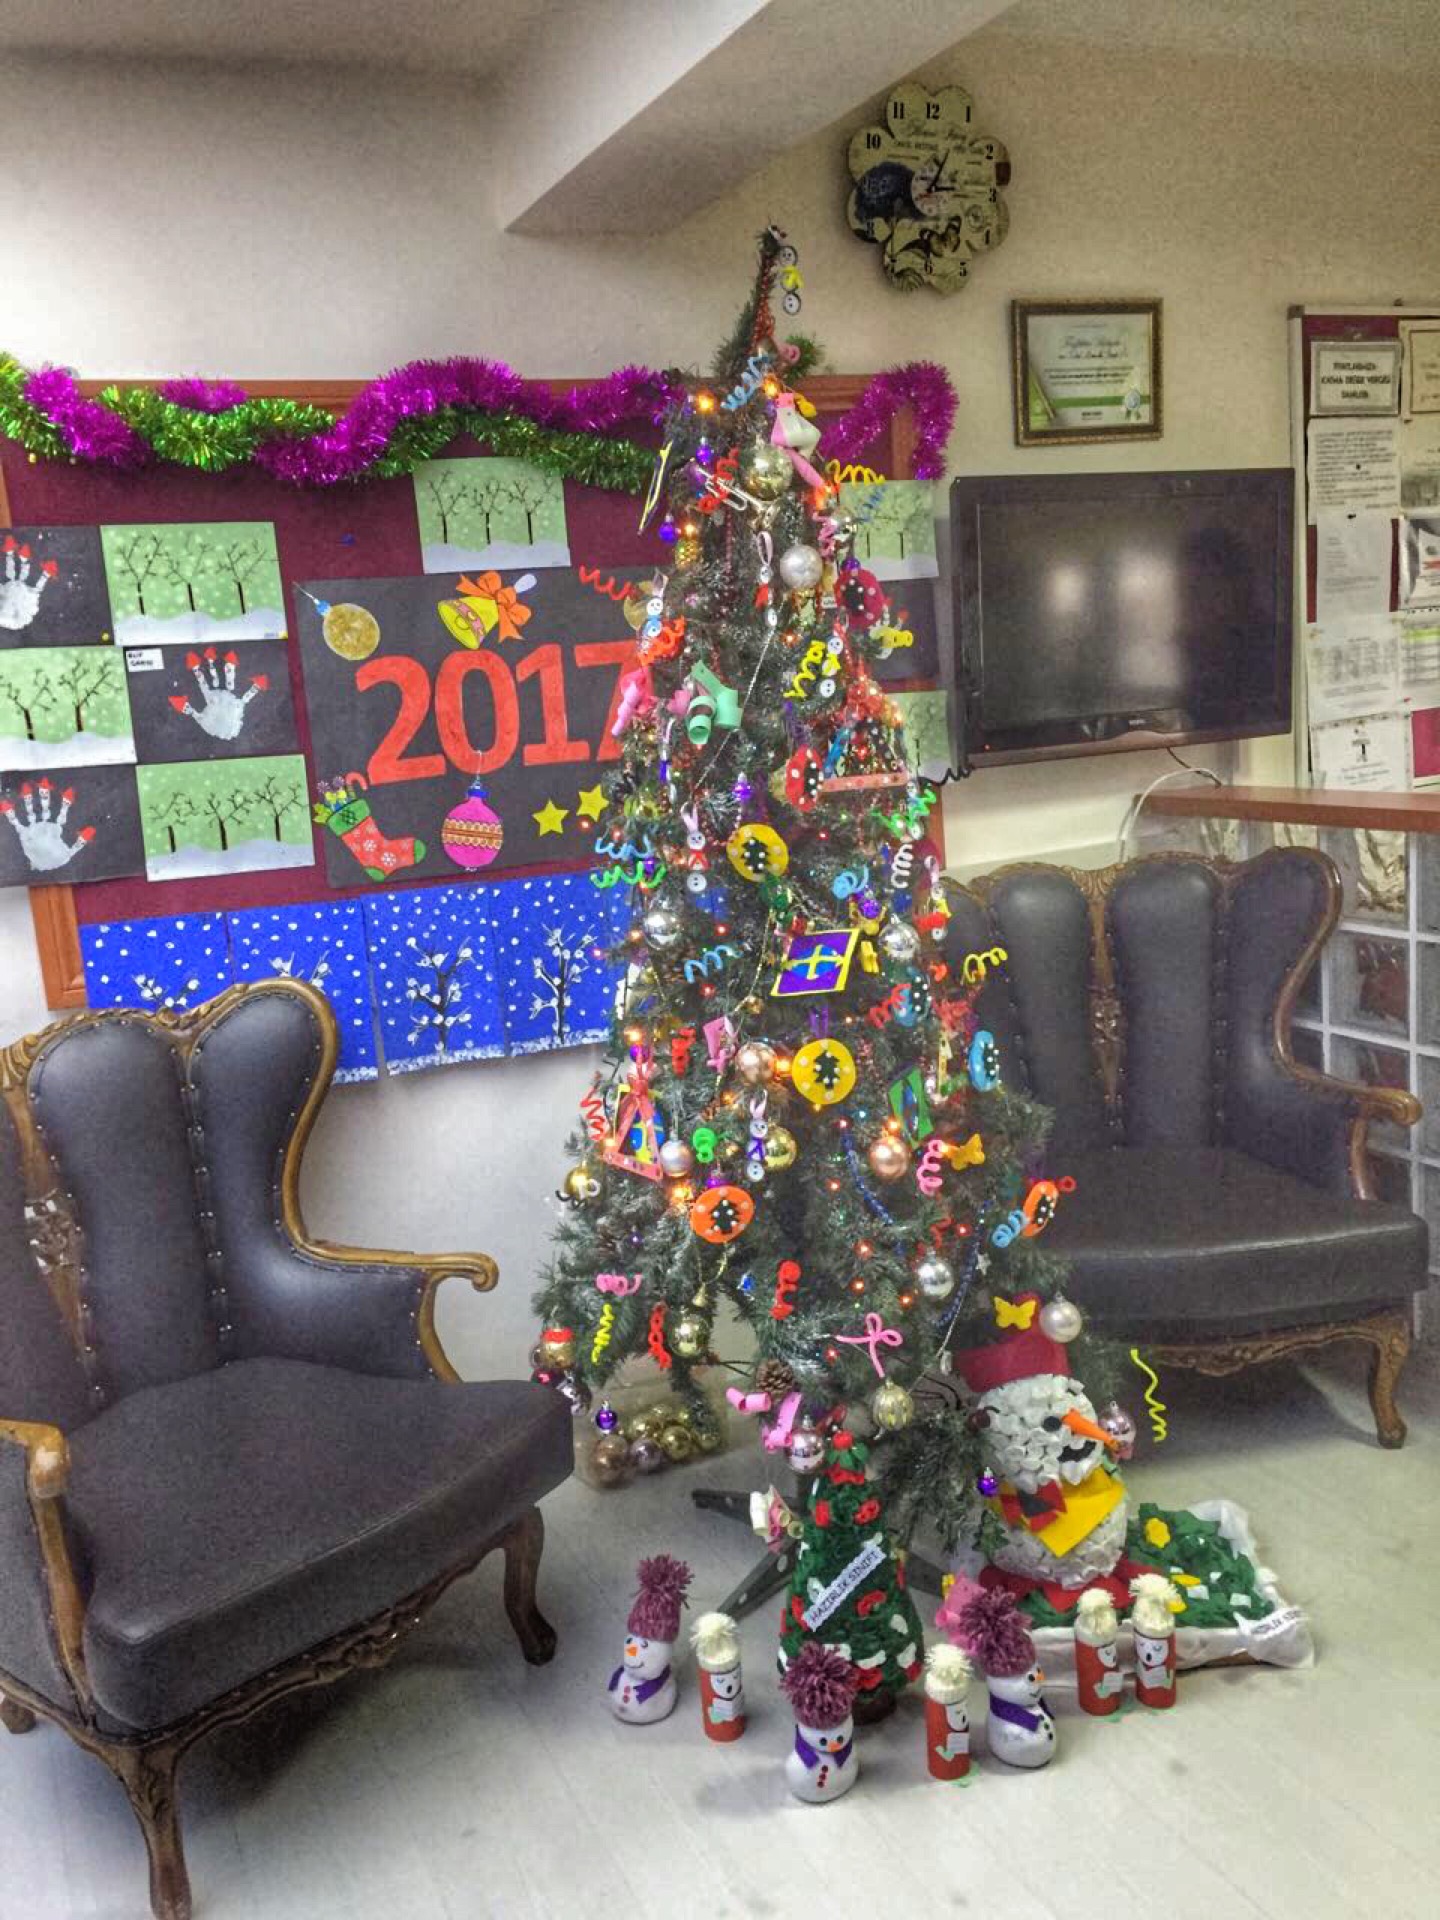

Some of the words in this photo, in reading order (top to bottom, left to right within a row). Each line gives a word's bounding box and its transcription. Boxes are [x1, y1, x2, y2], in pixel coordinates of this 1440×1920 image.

[893, 102, 904, 119] 11
[926, 102, 939, 120] 12
[966, 106, 971, 123] 1
[866, 133, 881, 149] 10
[986, 145, 993, 160] 2
[960, 262, 967, 276] 5
[355, 640, 642, 785] 2017
